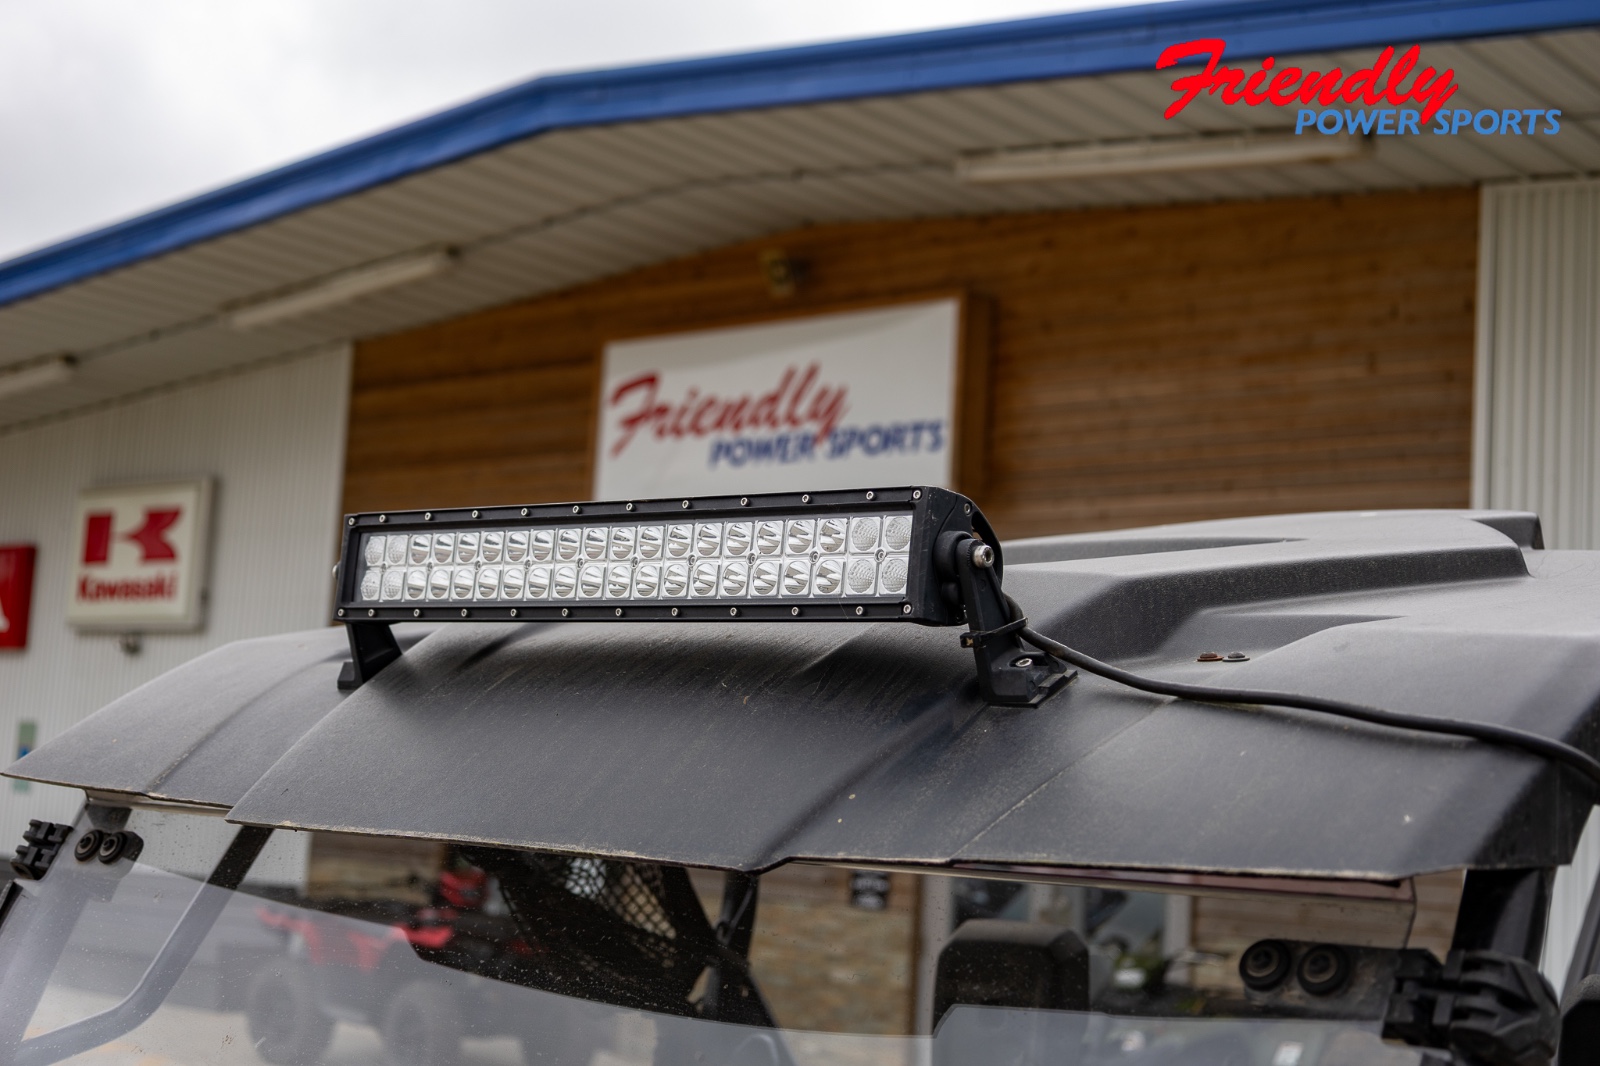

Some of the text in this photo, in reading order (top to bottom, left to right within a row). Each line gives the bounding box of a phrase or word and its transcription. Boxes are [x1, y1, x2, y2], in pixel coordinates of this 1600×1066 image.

[607, 362, 848, 459] Friendly
[708, 419, 943, 469] POWER SPORTS
[78, 574, 178, 602] Kawasaki
